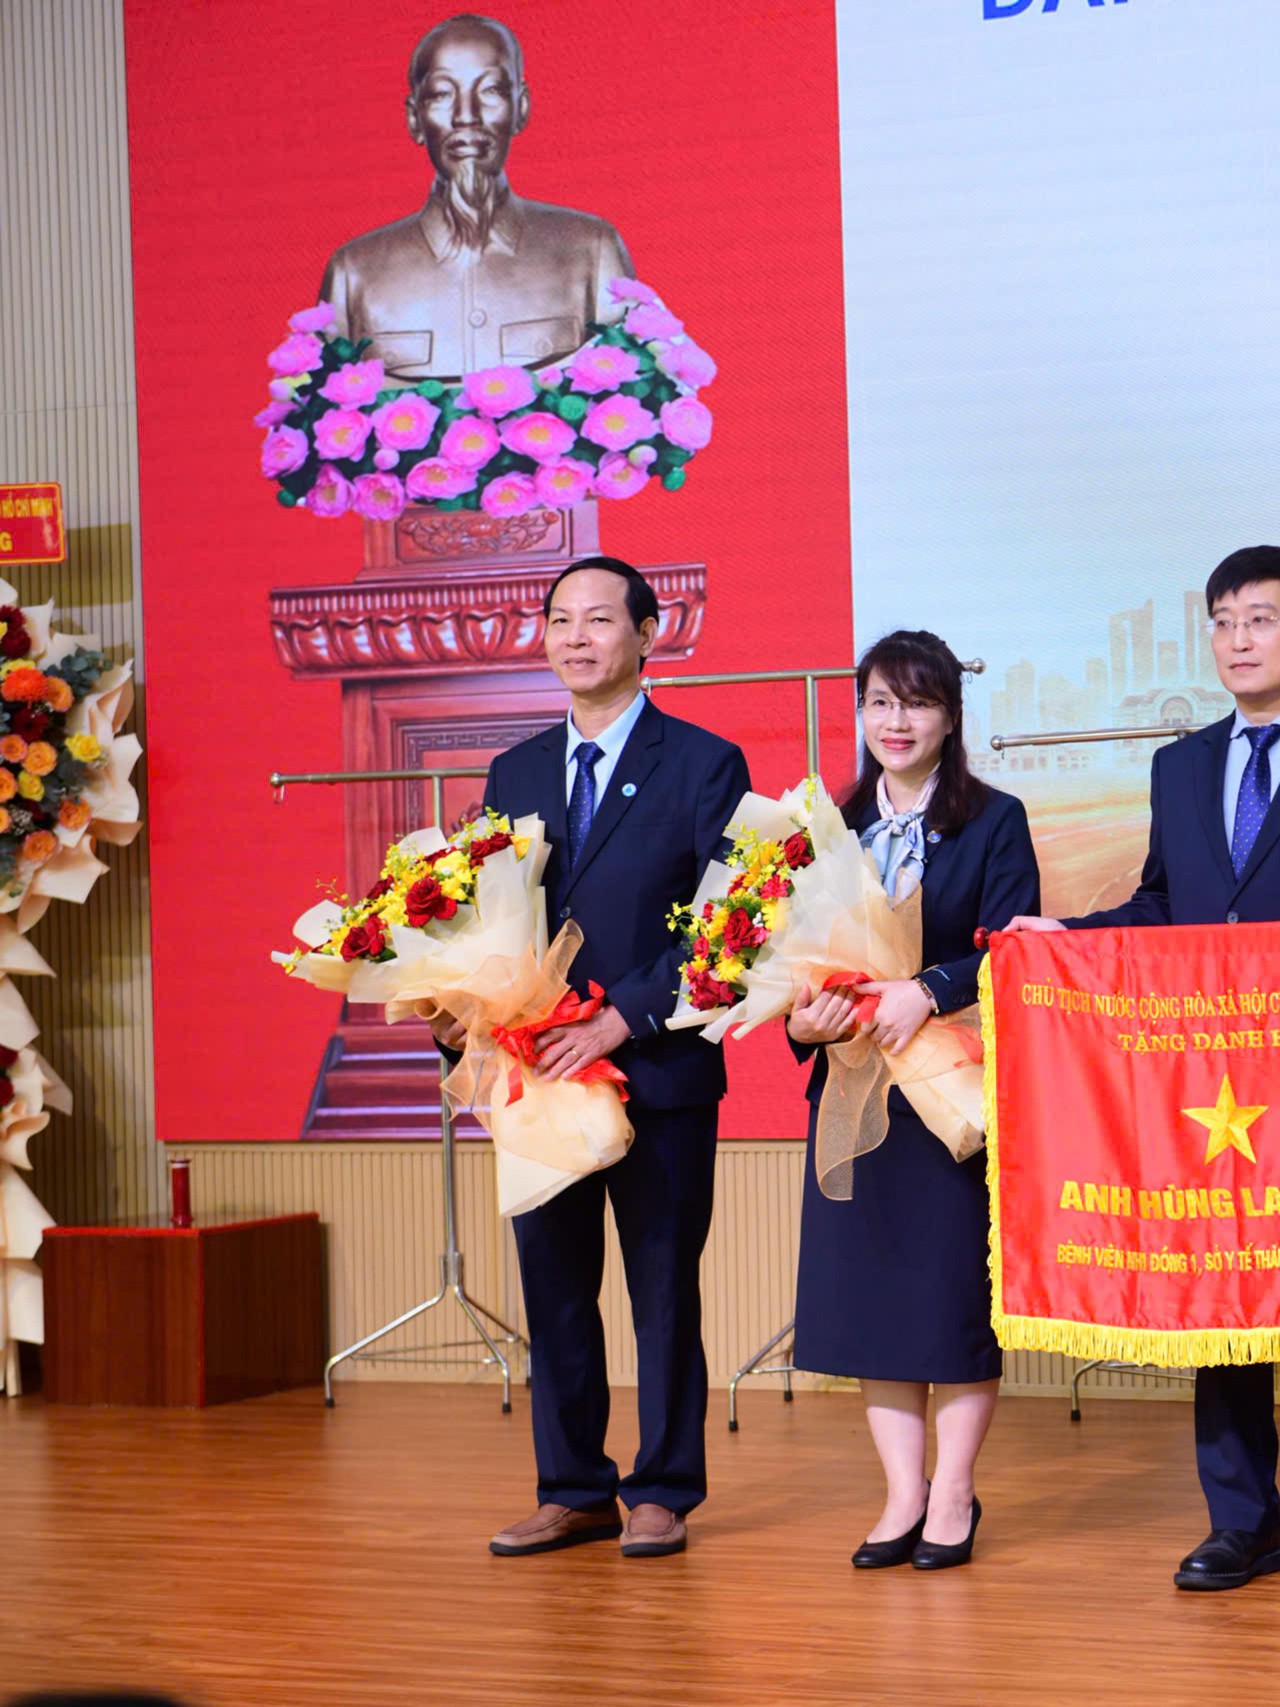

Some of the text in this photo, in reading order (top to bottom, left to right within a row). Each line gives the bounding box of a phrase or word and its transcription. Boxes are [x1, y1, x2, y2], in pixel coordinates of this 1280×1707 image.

[1021, 978, 1055, 1007] CHỦ
[1056, 987, 1091, 1015] TỊCH
[1094, 990, 1136, 1019] NƯỚC
[1138, 992, 1181, 1024] CỘNG
[1183, 990, 1215, 1018] HÒA
[1239, 986, 1267, 1020] HỘI
[1118, 1030, 1186, 1055] TẶNG
[1192, 1030, 1265, 1051] DANH
[1059, 1180, 1132, 1217] ANH
[1138, 1184, 1236, 1221] HÙNG
[1056, 1239, 1092, 1269] BỆNH
[1093, 1243, 1125, 1274] VIỆN
[1190, 1253, 1203, 1277] 1,
[1223, 1250, 1235, 1271] Y
[1236, 1242, 1254, 1272] TẾ
